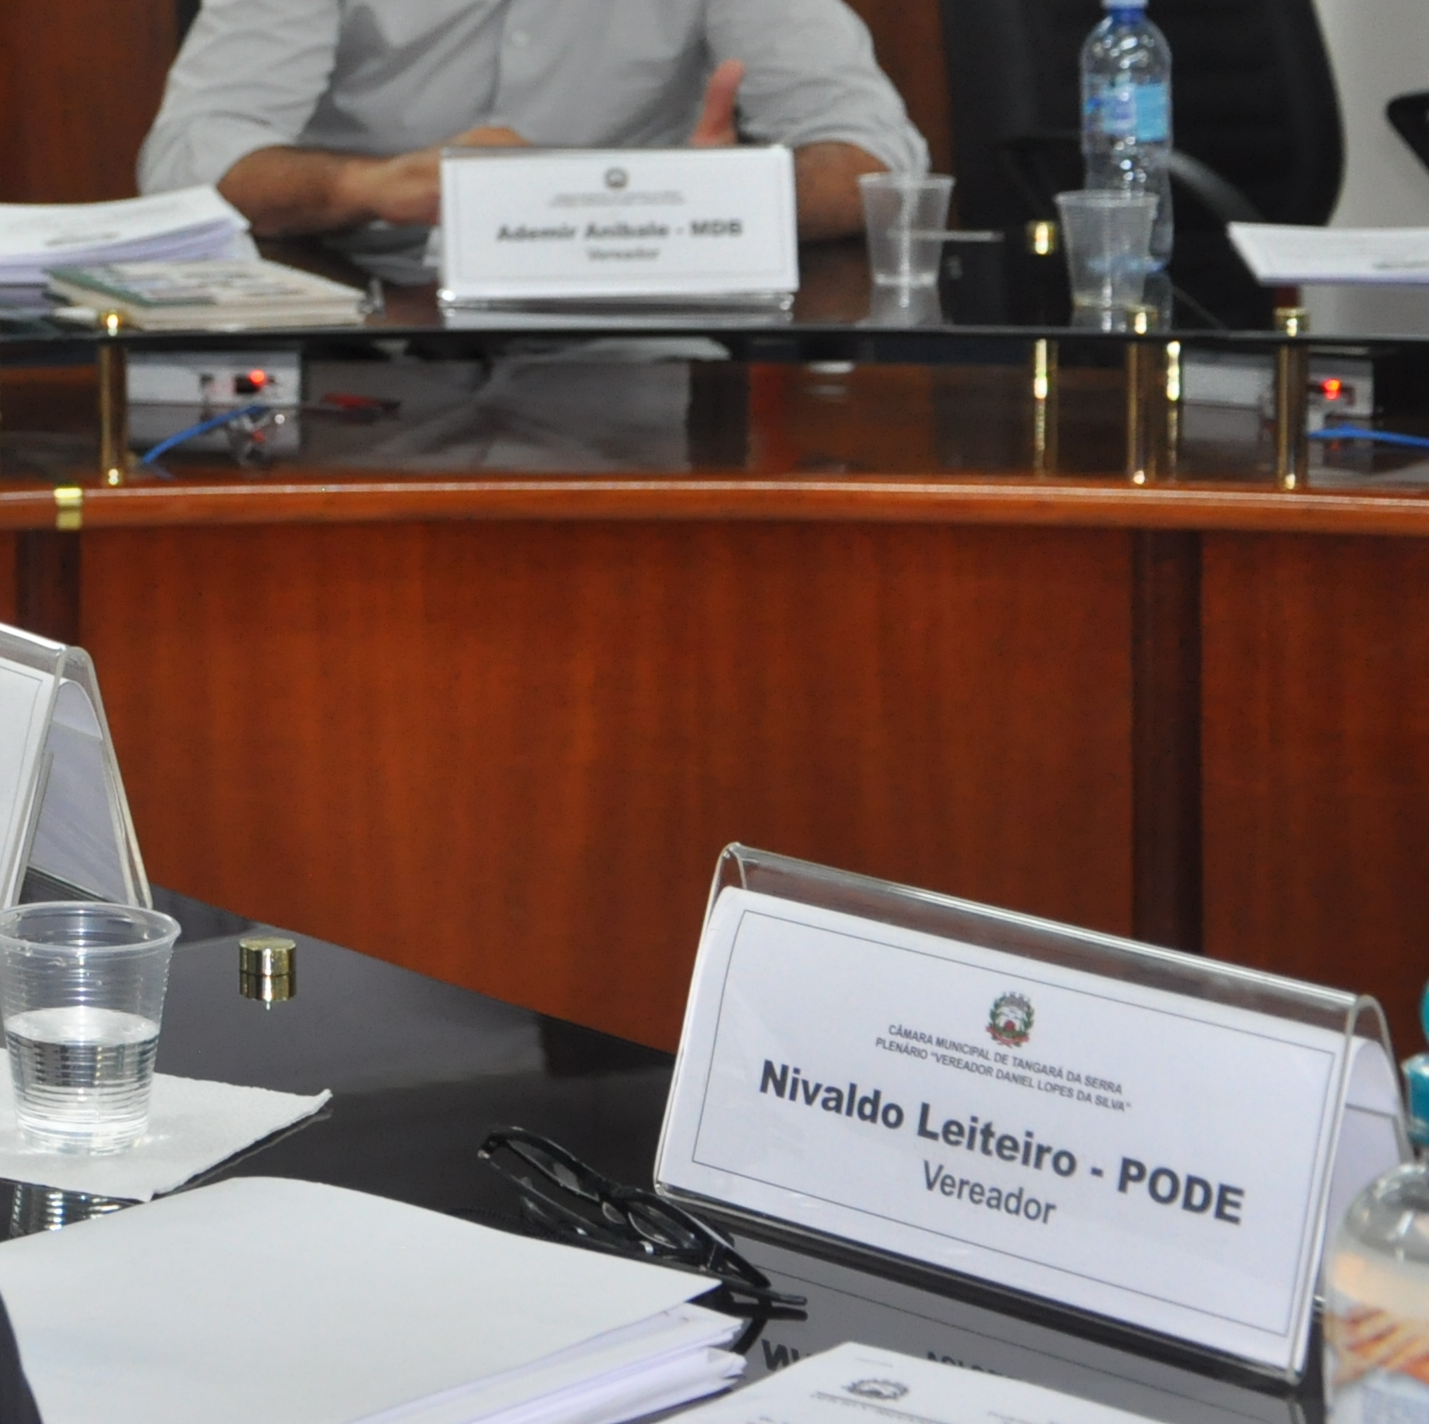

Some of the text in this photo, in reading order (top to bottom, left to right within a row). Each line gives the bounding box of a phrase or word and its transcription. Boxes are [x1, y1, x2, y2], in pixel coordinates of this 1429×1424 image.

[496, 222, 577, 243] Ademir
[584, 219, 669, 240] Anibale
[690, 218, 744, 238] MDB
[875, 1037, 928, 1061] PLENÁRIO
[996, 1068, 1035, 1089] DANIEL
[1037, 1079, 1075, 1100] LOPES
[1077, 1089, 1093, 1103] DA
[888, 1024, 1123, 1095] CÂMARA MUNICIPAL DE TANGARÁ DA SERRA
[759, 1058, 905, 1129] Nivaldo
[915, 1101, 1079, 1179] Leiteiro
[1117, 1155, 1246, 1227] PODE
[923, 1159, 1058, 1227] Vereador
